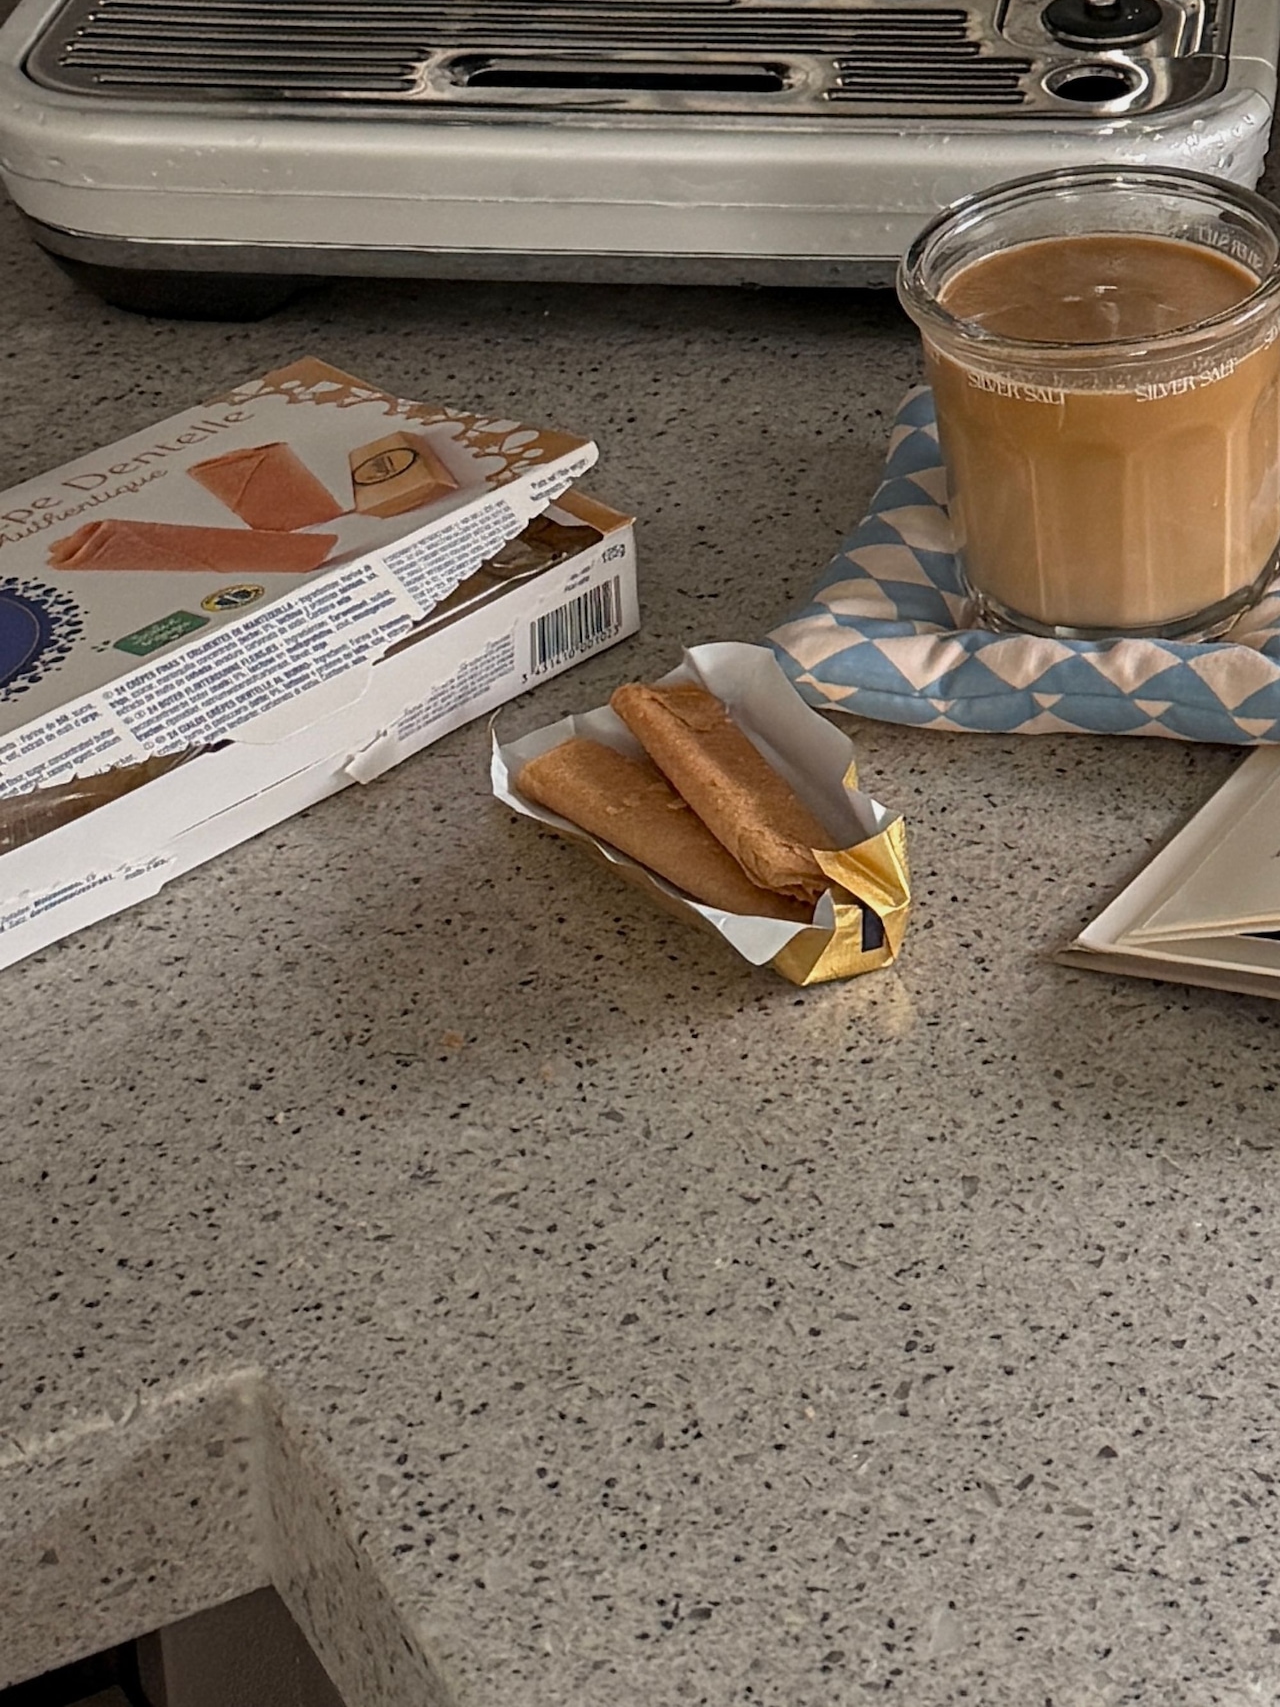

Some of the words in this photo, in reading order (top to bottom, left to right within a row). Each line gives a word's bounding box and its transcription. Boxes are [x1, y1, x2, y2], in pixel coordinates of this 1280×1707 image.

[967, 370, 1020, 400] SILVER
[1024, 386, 1066, 406] SALT
[1134, 377, 1197, 403] SILVER
[1199, 357, 1239, 387] SALT
[0, 496, 64, 531] pe
[62, 411, 254, 491] Dentelle
